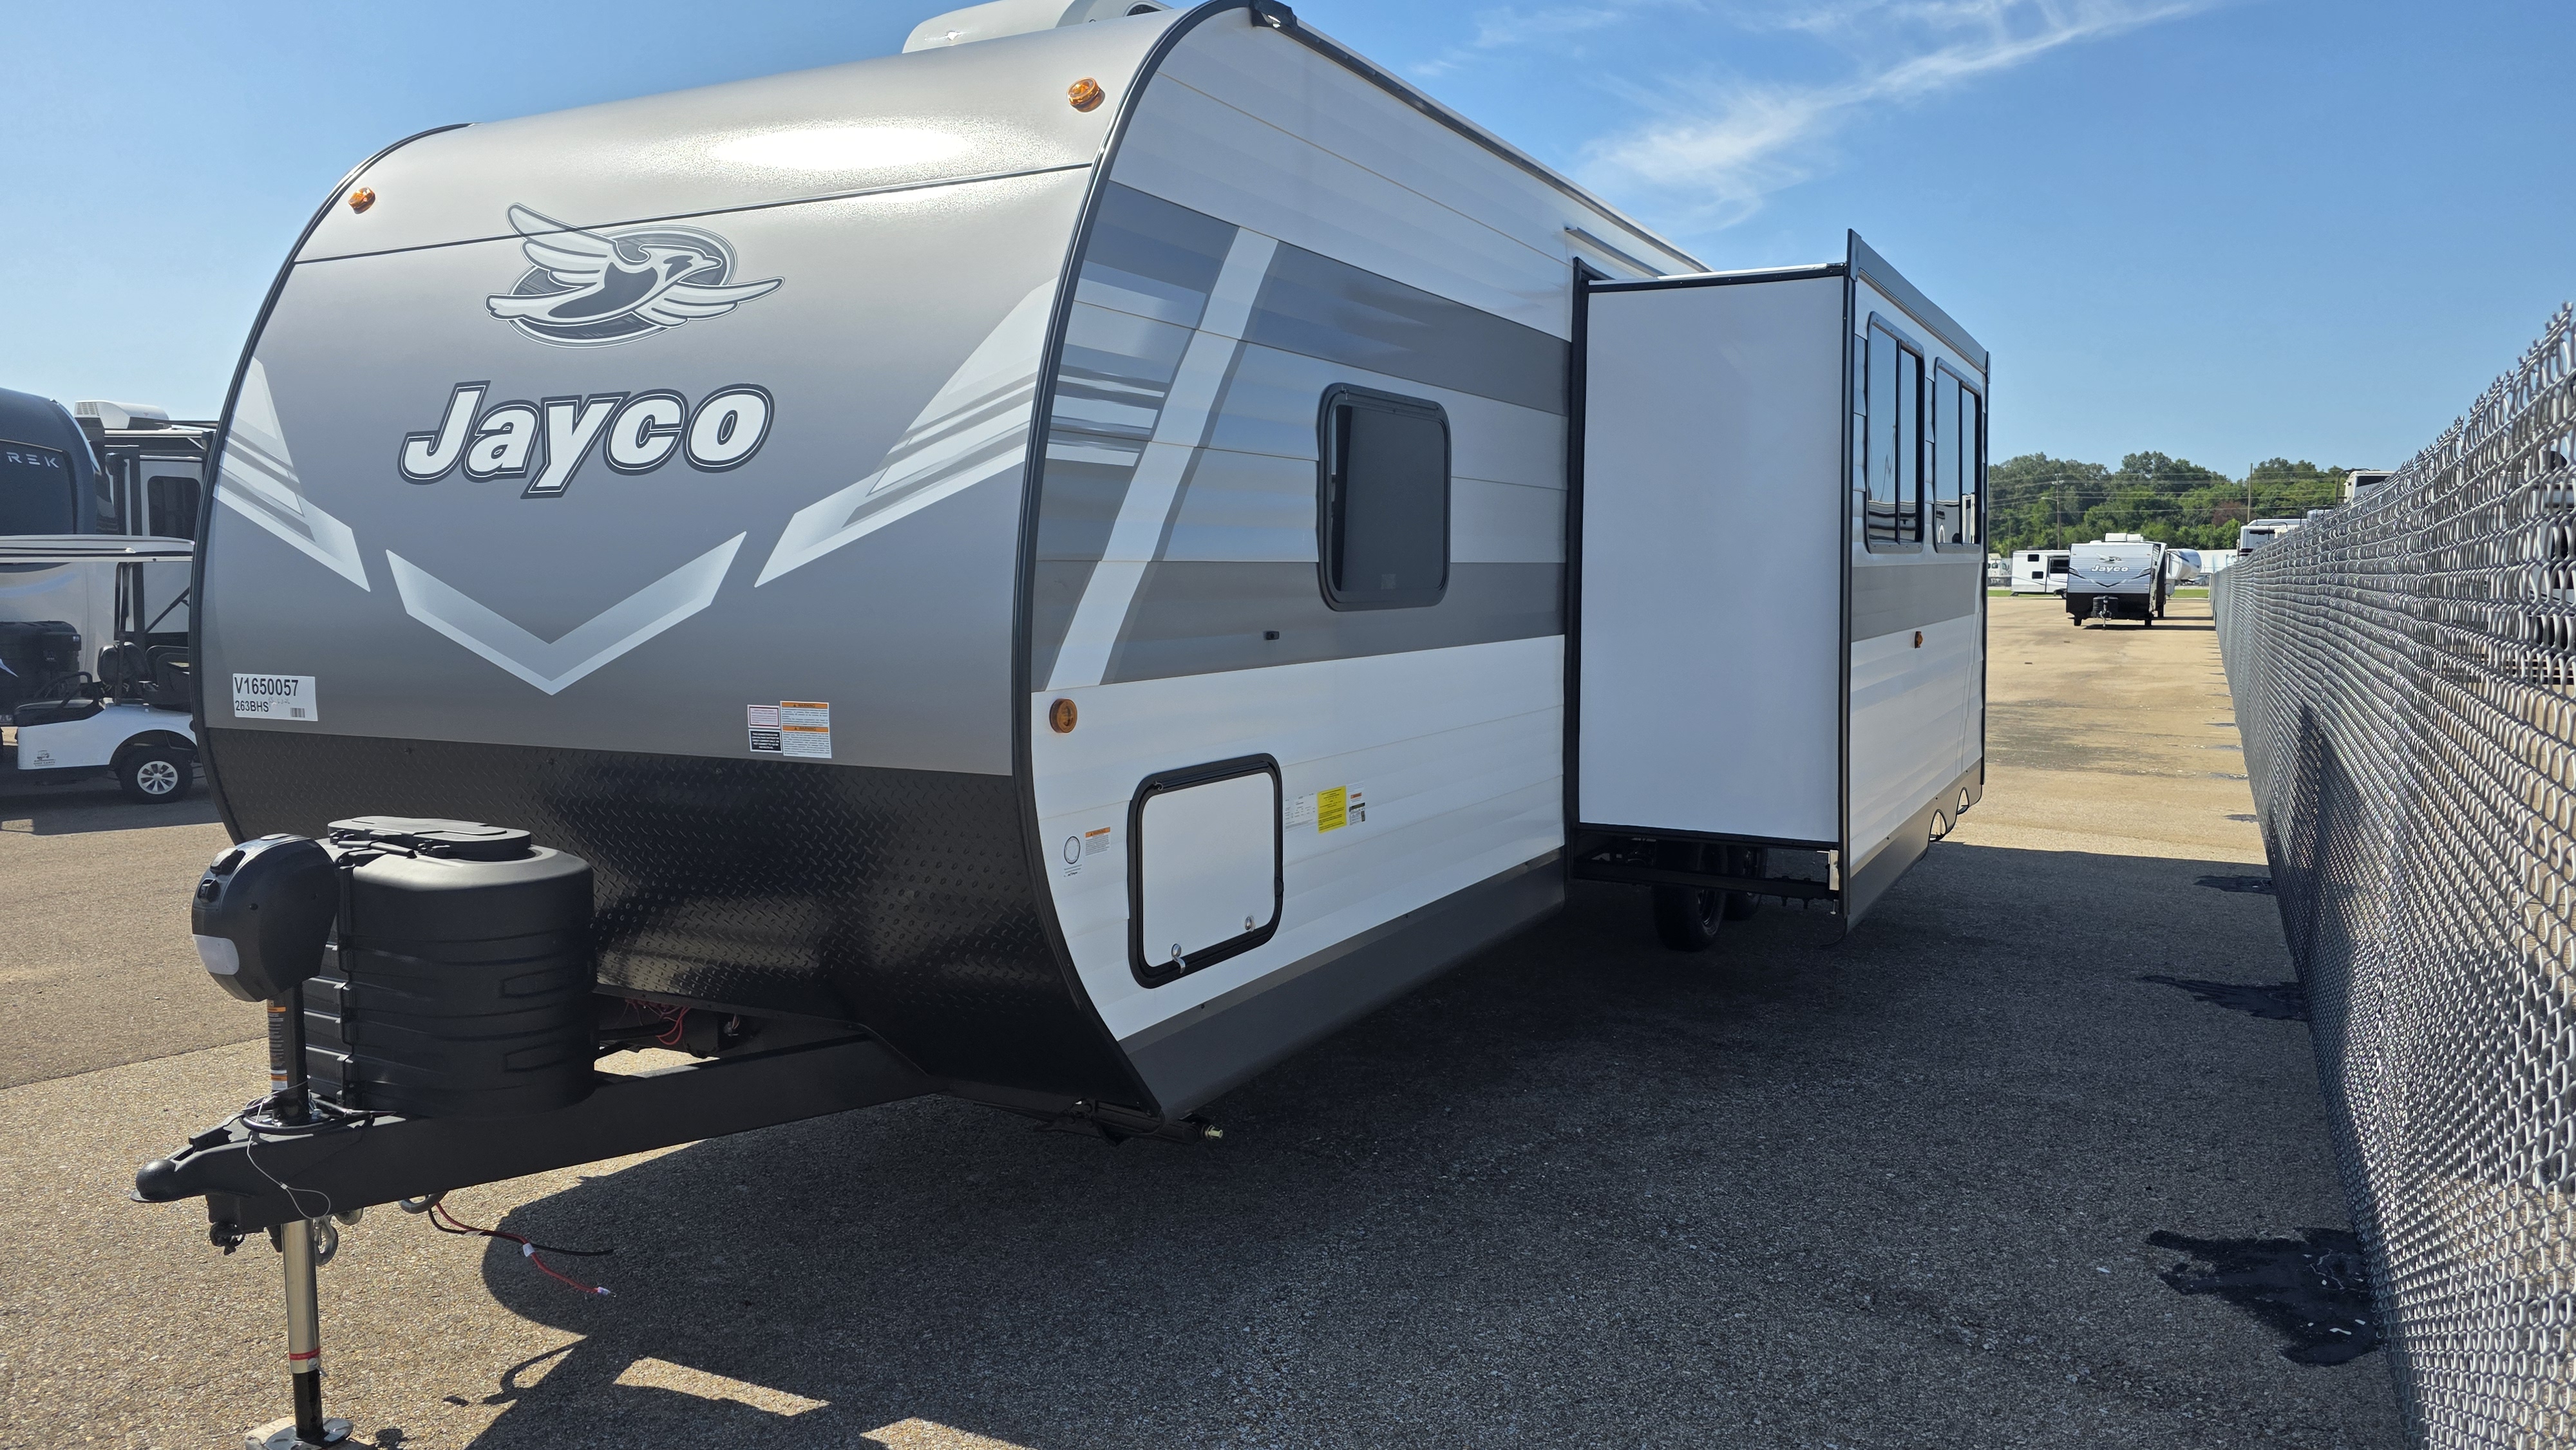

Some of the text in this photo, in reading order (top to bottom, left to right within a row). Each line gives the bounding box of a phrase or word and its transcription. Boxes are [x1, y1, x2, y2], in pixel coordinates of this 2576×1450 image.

[398, 380, 775, 499] Jayco
[2090, 565, 2129, 574] Jayco
[234, 677, 299, 697] V1650057
[235, 700, 269, 713] 263BHS
